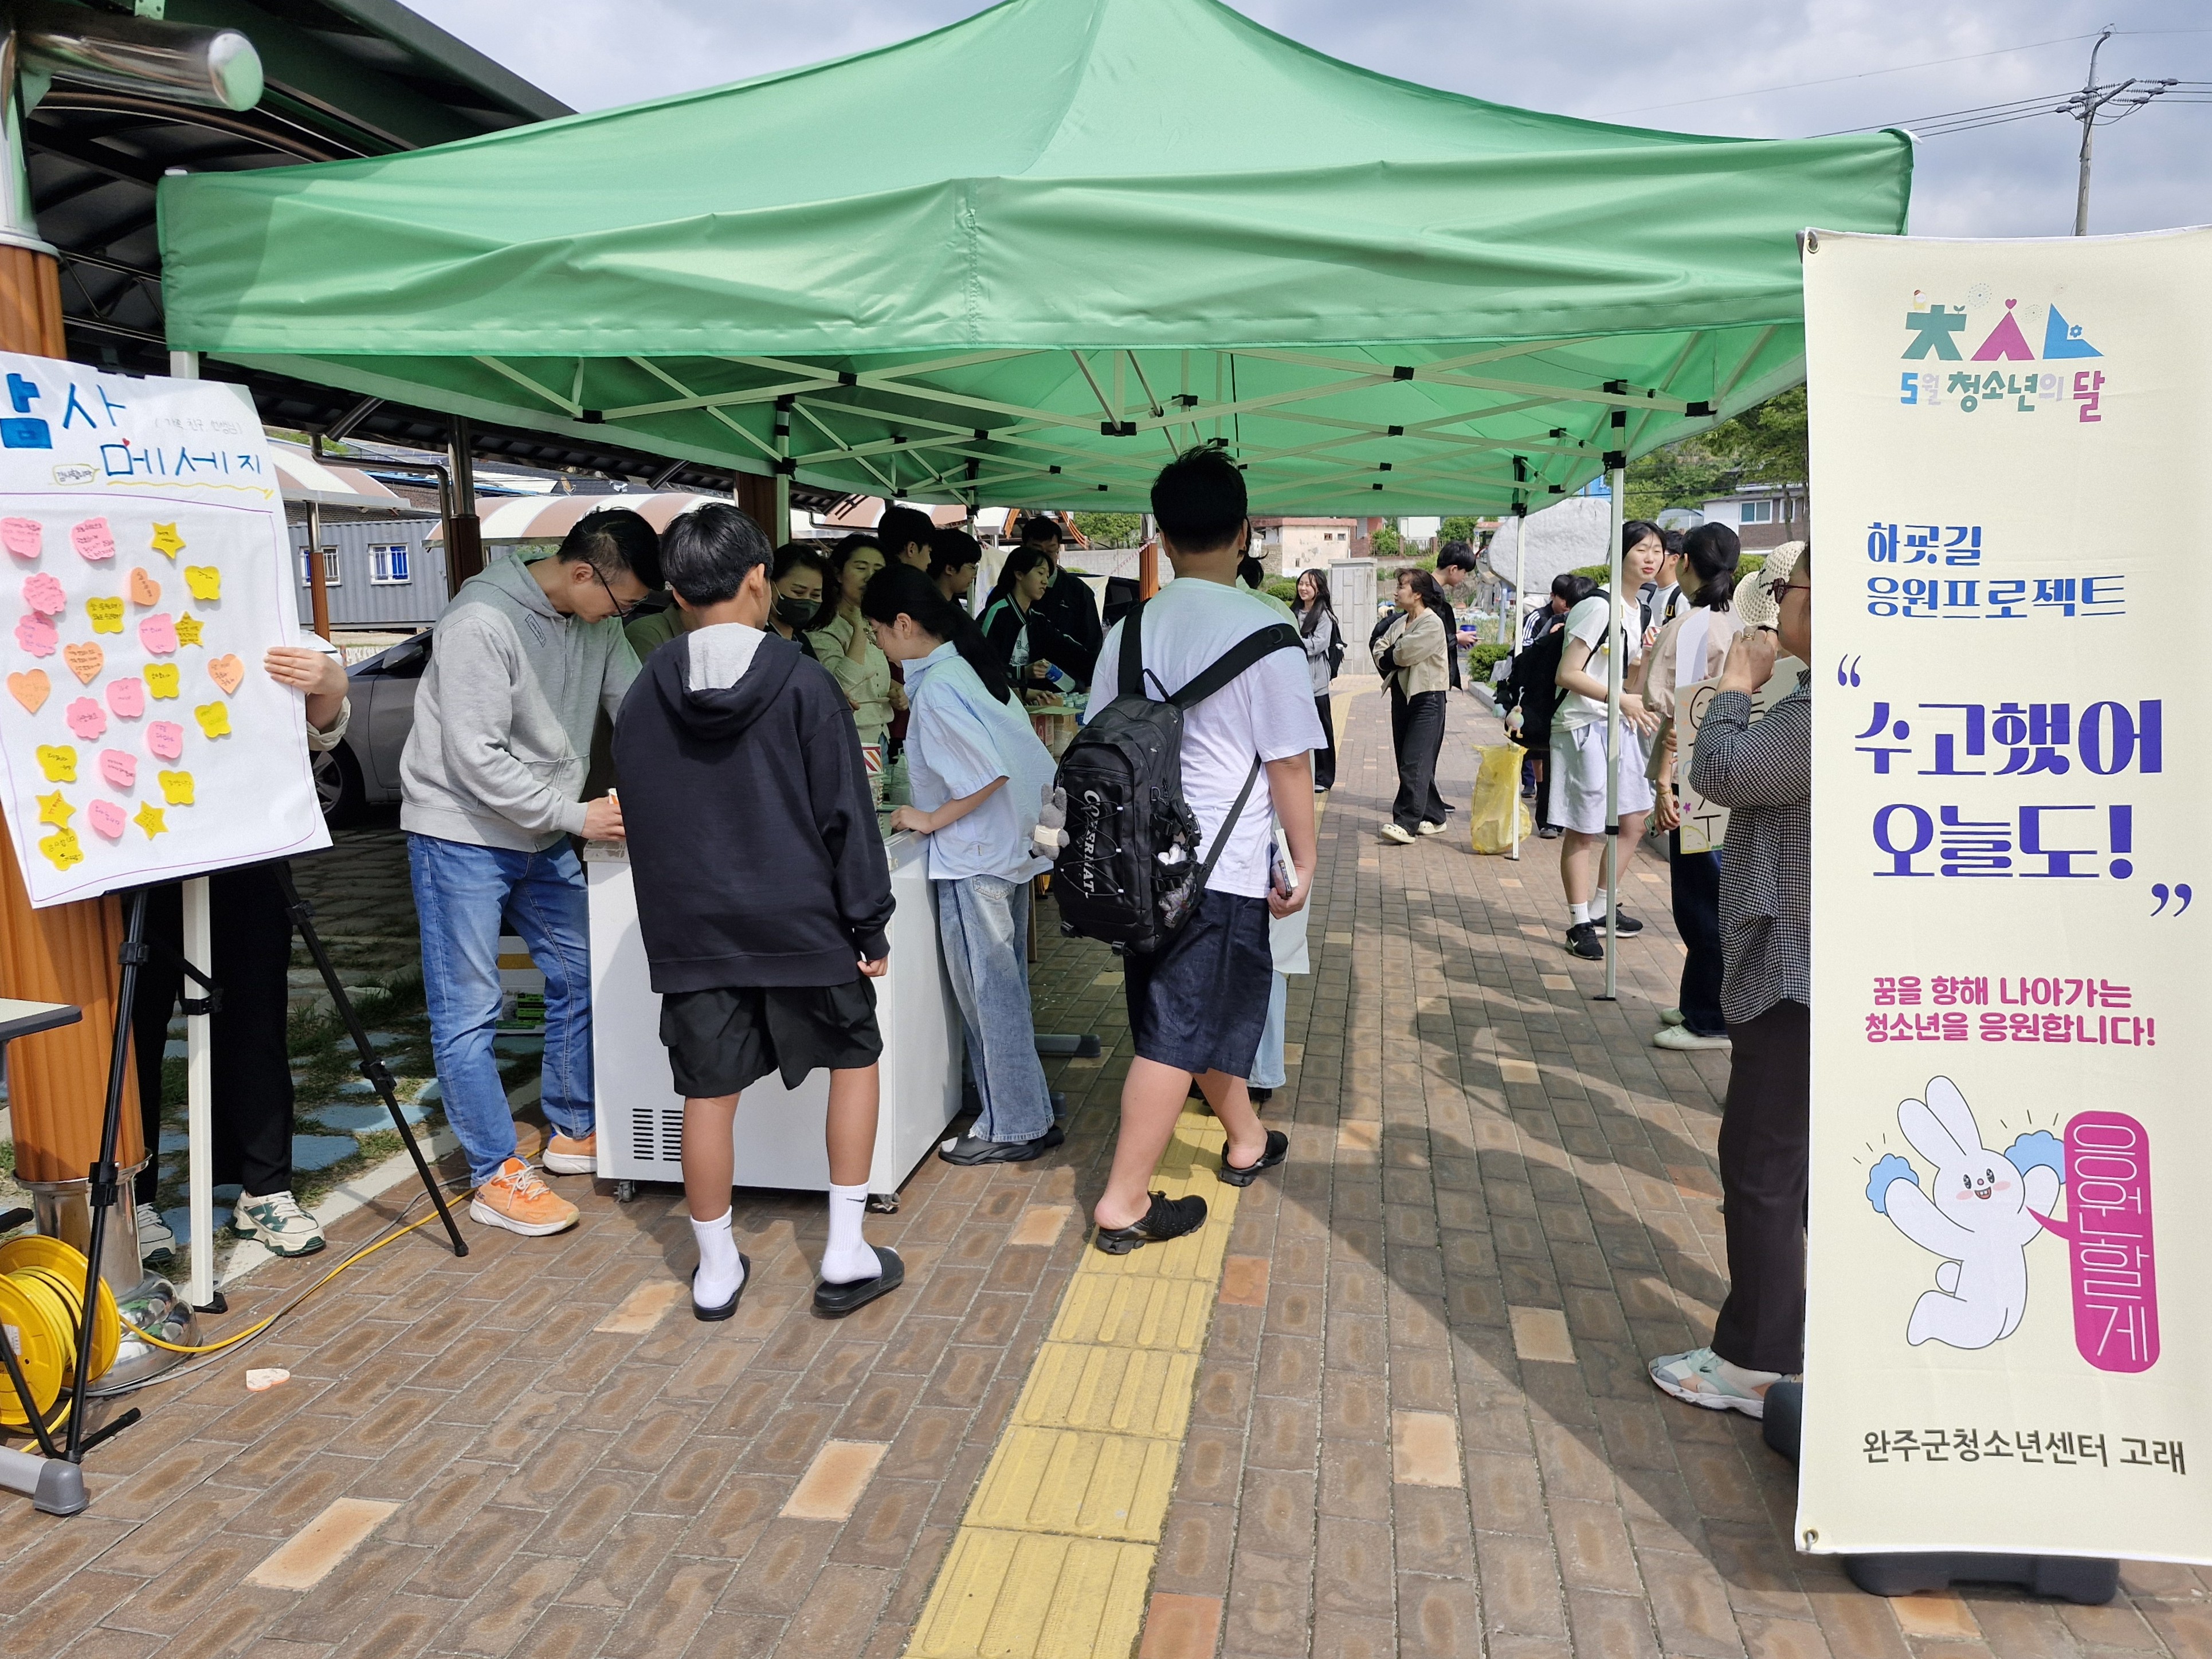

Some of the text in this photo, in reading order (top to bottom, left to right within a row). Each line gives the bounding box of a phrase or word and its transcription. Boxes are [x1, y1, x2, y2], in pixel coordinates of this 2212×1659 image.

[1901, 371, 2105, 423] 5월 청소년의 달
[100, 444, 261, 477] 메세지
[1868, 522, 1982, 566] 하굣길
[1868, 575, 2126, 619] 응원프로젝트
[1873, 976, 2132, 1009] 꿈을 향해 나아가는
[1865, 1012, 2156, 1046] 청소년을 응원합니다!
[2073, 1123, 2150, 1363] 응원할게
[1863, 1429, 2186, 1476] 완주군청소년센터 고래
